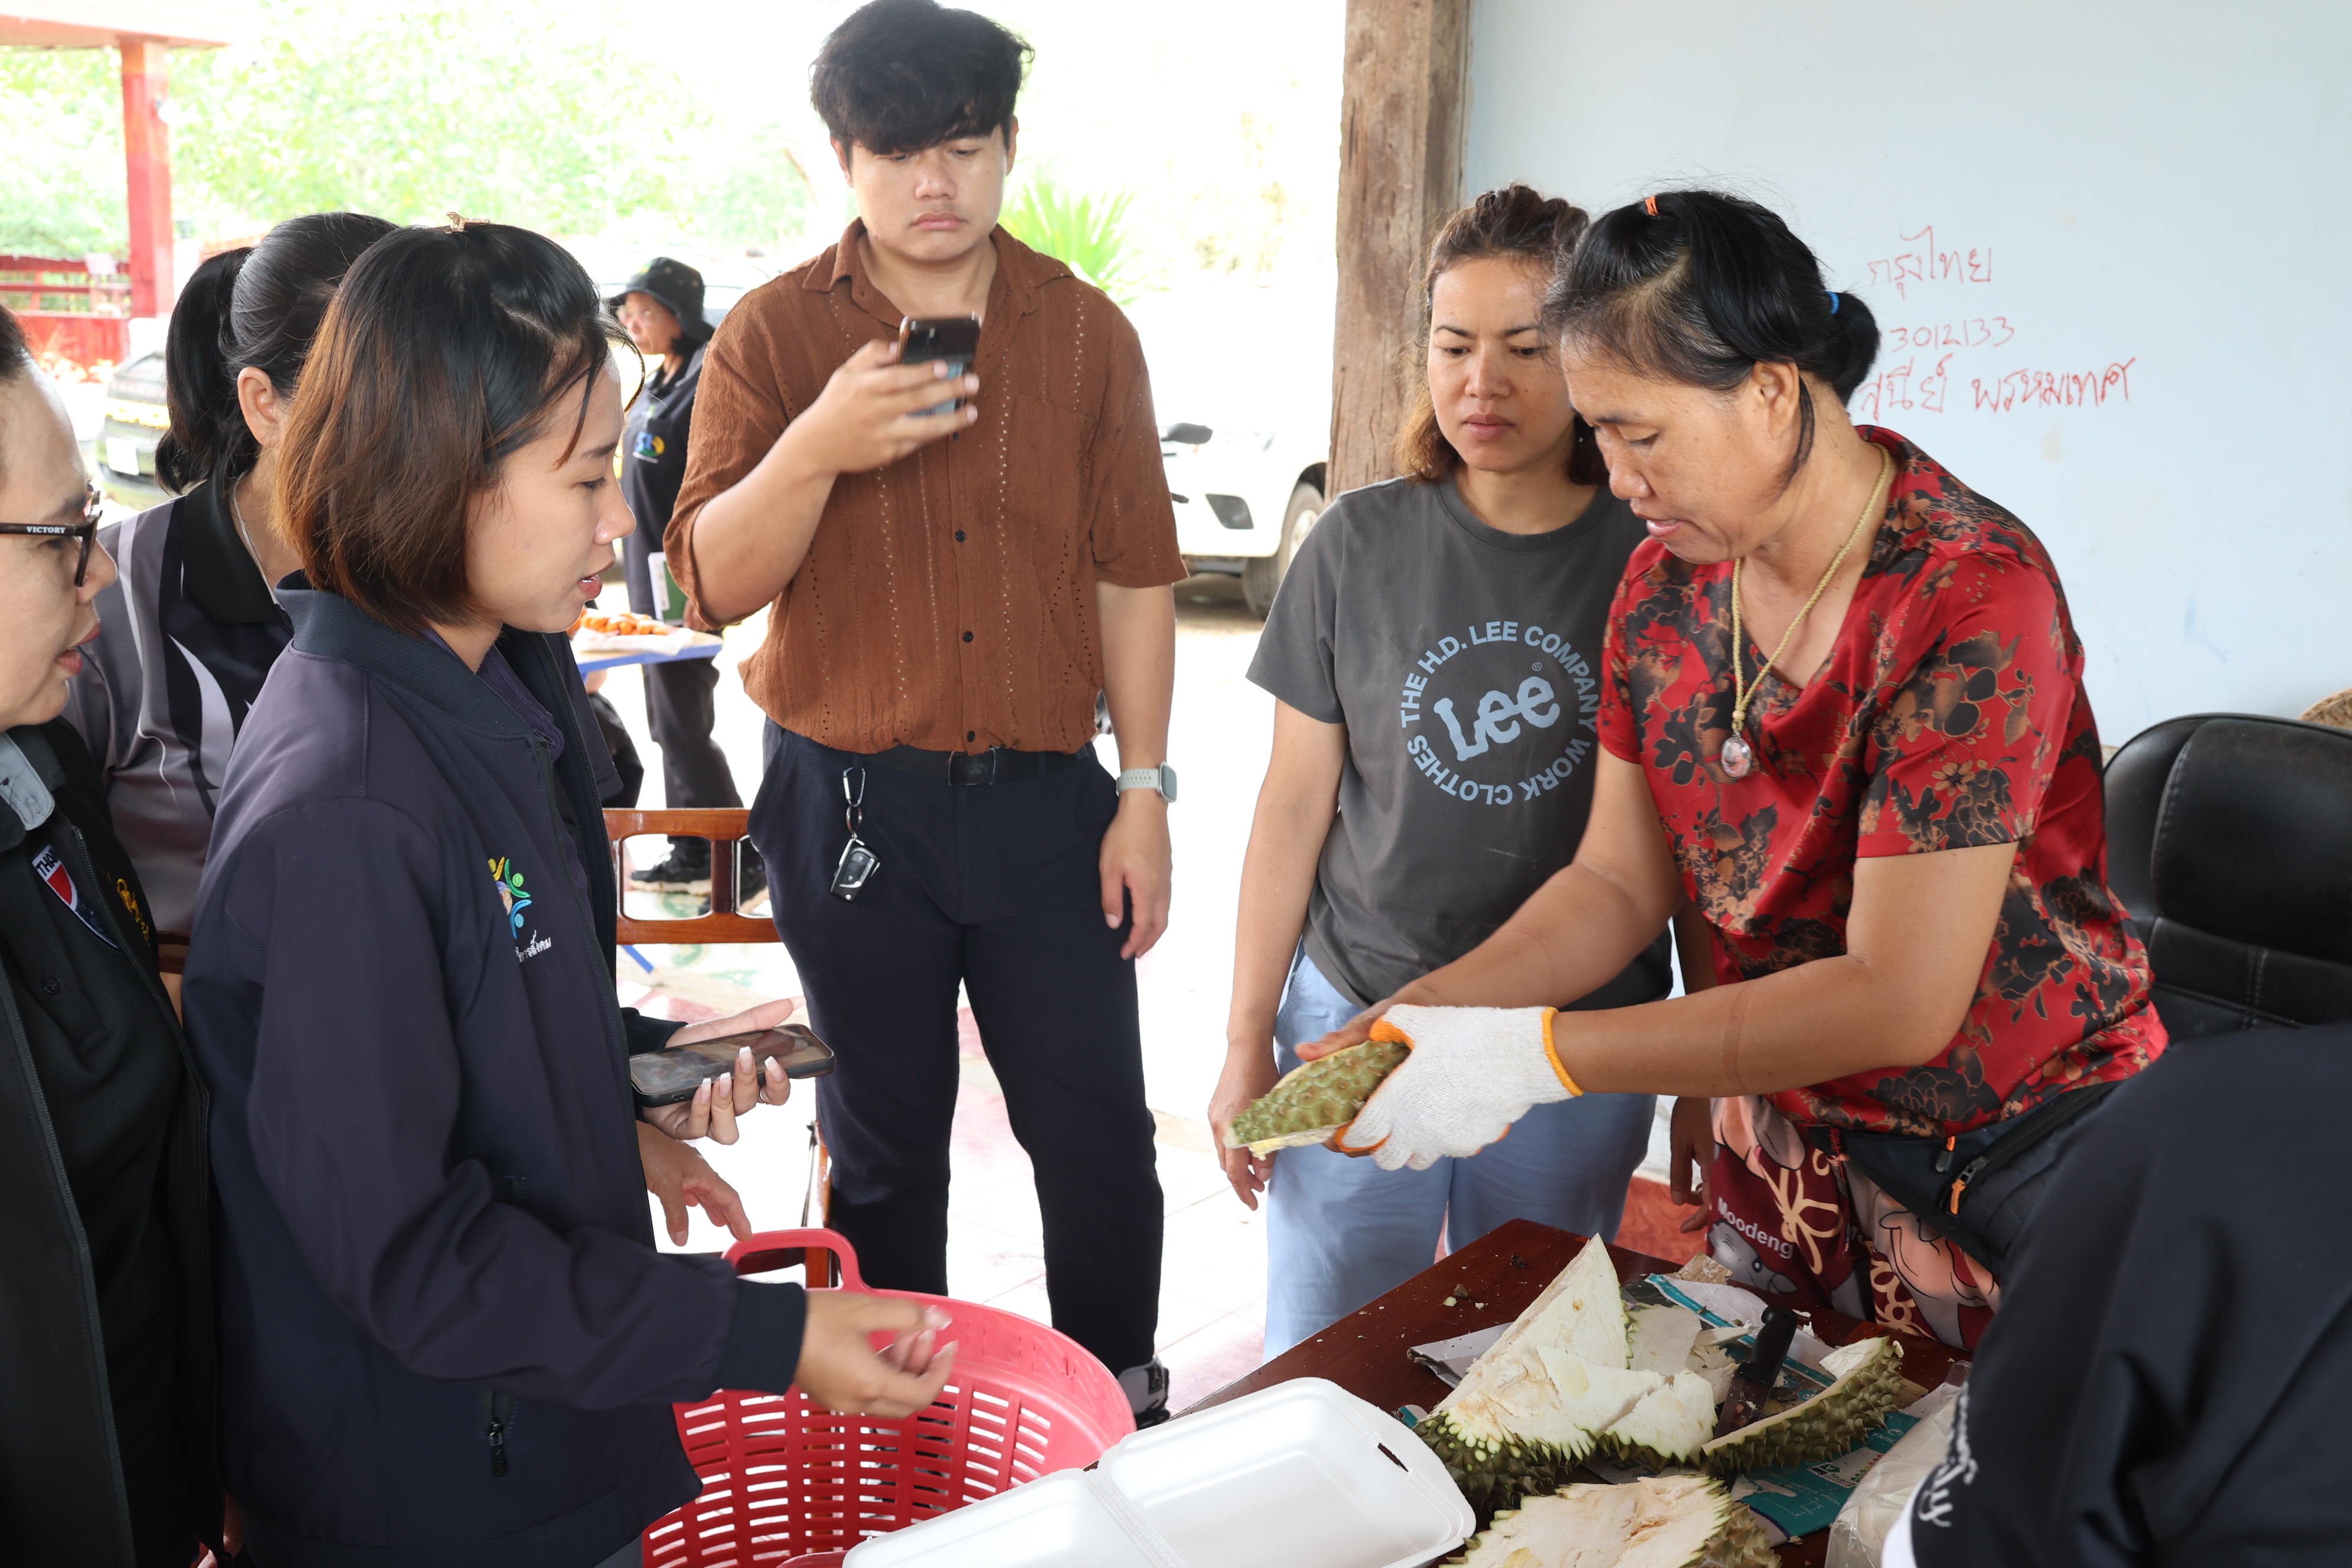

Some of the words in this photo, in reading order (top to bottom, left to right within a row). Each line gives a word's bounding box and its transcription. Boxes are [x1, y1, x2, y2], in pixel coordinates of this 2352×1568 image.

[1867, 226, 1992, 300] กรุงไทย
[1879, 317, 2014, 352] 3012133
[1417, 636, 1468, 674] H.D.
[1468, 620, 1518, 645] LEE
[1400, 672, 1428, 728] THE
[1524, 625, 1599, 733] COMPANY
[1433, 676, 1560, 762] Lee
[1407, 734, 1513, 805] CLOTHES
[1517, 738, 1592, 801] WORK
[1717, 1197, 1794, 1259] Moodeng
